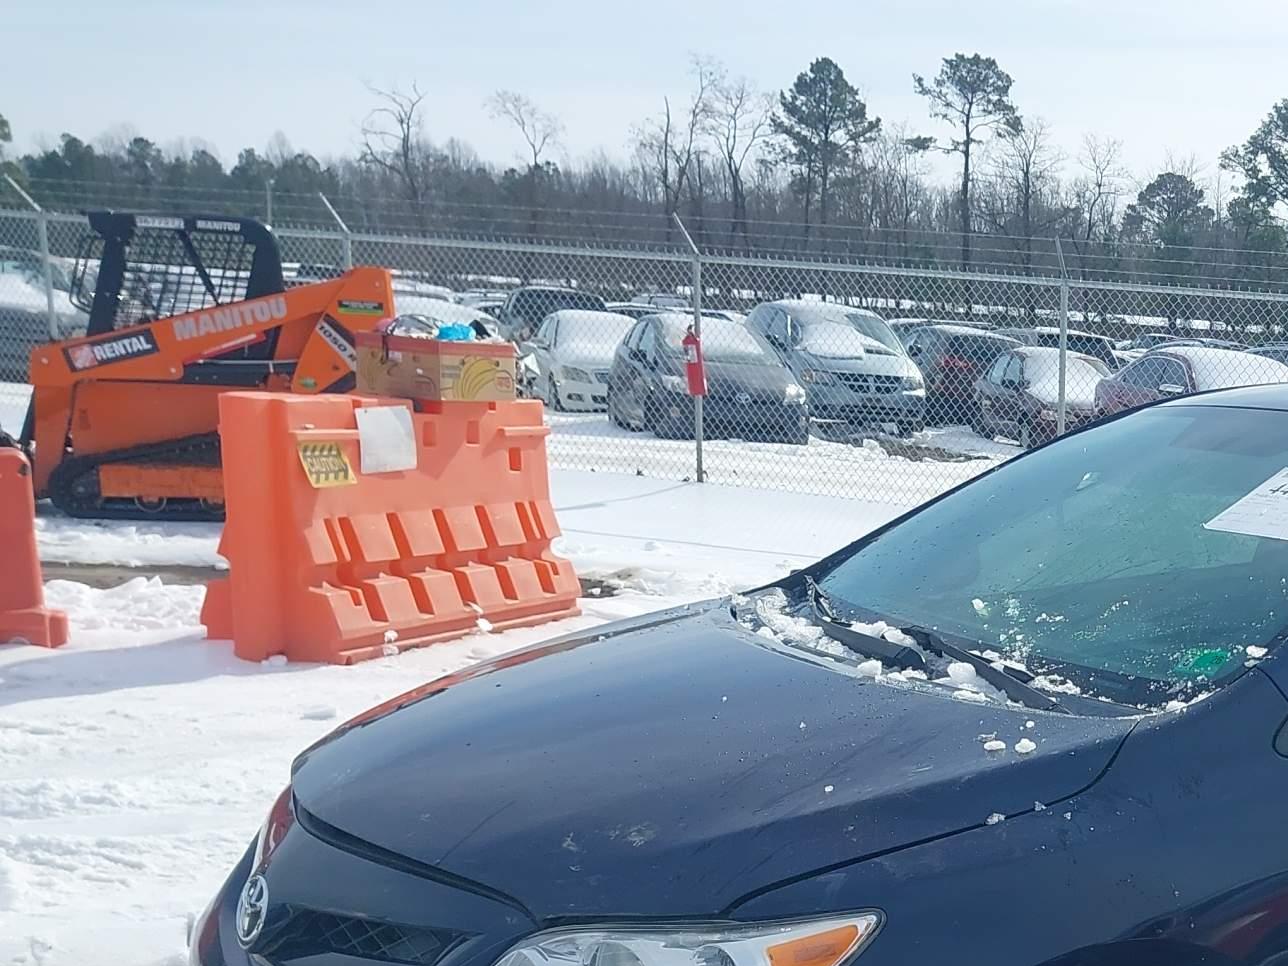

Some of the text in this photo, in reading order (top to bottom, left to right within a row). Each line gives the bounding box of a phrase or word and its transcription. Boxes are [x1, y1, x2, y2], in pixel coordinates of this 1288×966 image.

[196, 219, 241, 232] MANITOU
[172, 296, 288, 341] MANITOU
[93, 335, 153, 361] RENTAL
[319, 324, 348, 352] 1050
